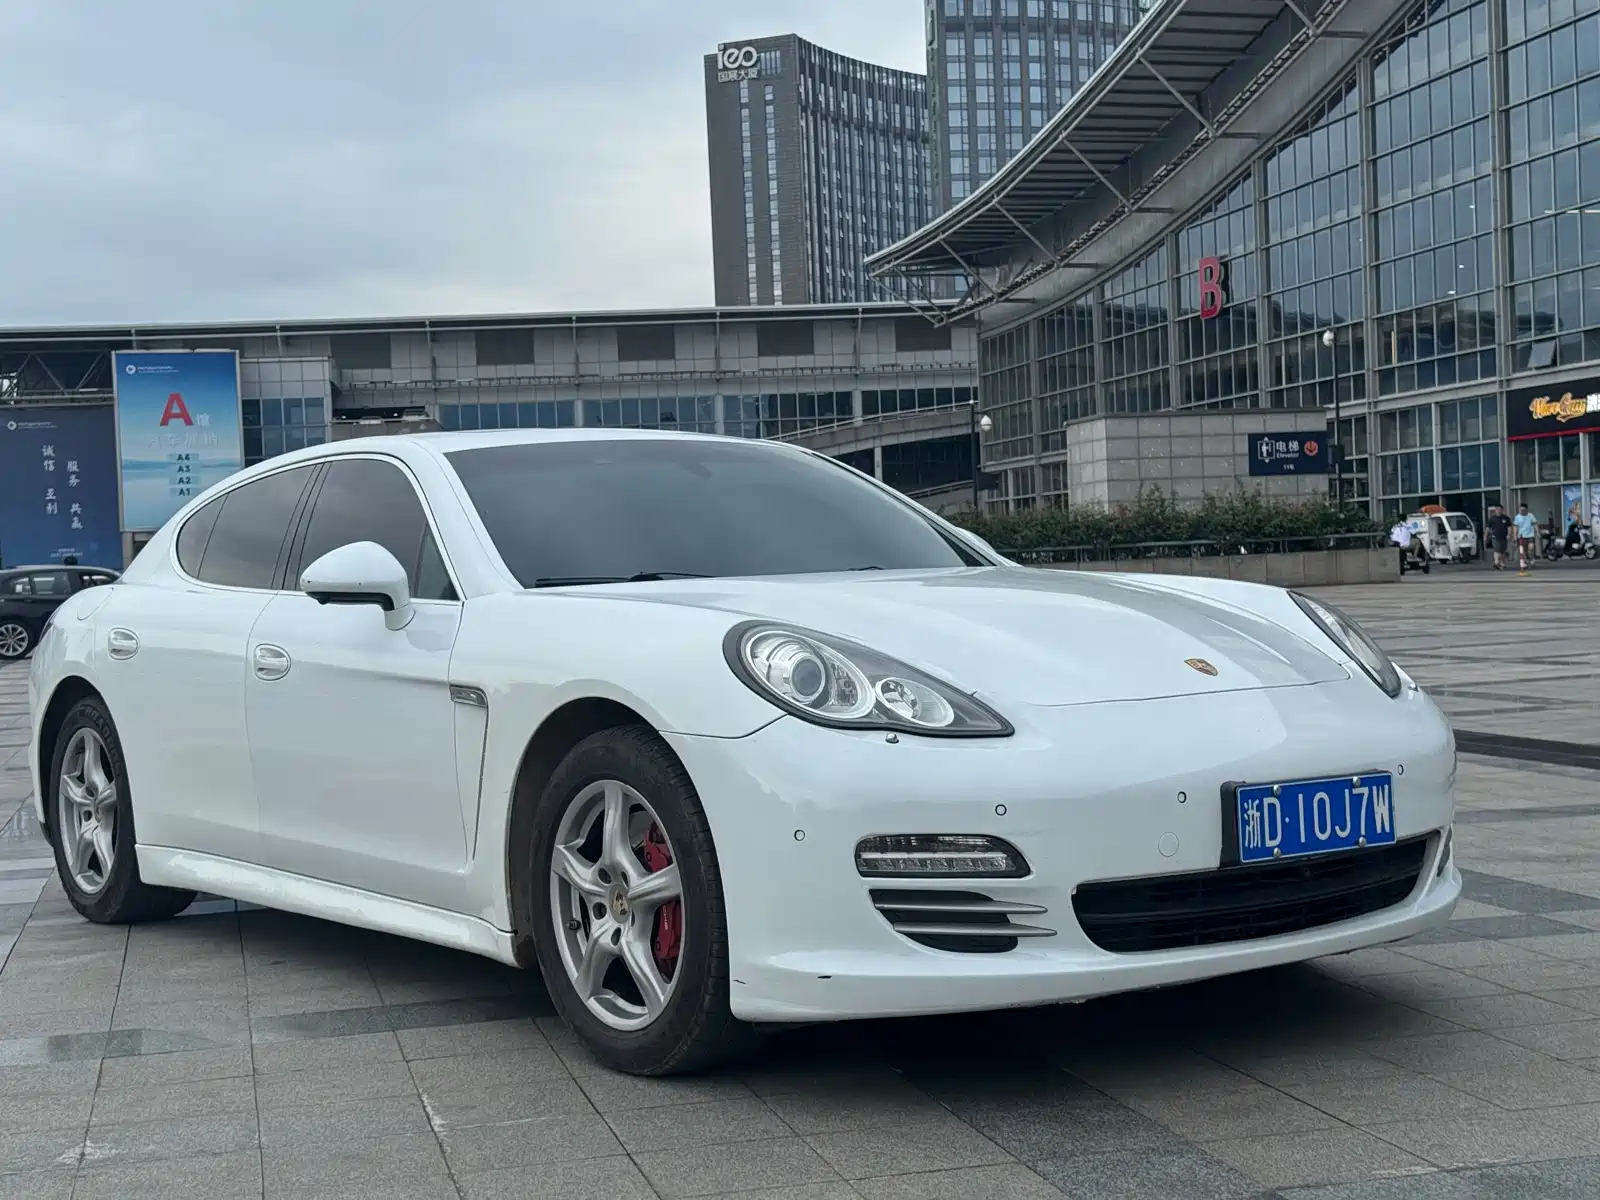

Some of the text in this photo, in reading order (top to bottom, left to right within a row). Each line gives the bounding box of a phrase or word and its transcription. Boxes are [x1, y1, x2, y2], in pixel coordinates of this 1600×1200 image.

[1198, 255, 1223, 321] B
[1275, 440, 1299, 453] 电梯
[67, 460, 80, 487] 服务
[177, 465, 191, 473] A3
[42, 444, 58, 515] 诚信 互利
[178, 476, 191, 485] A2
[178, 488, 191, 496] A1
[1244, 784, 1390, 849] 浙D·10J7W
